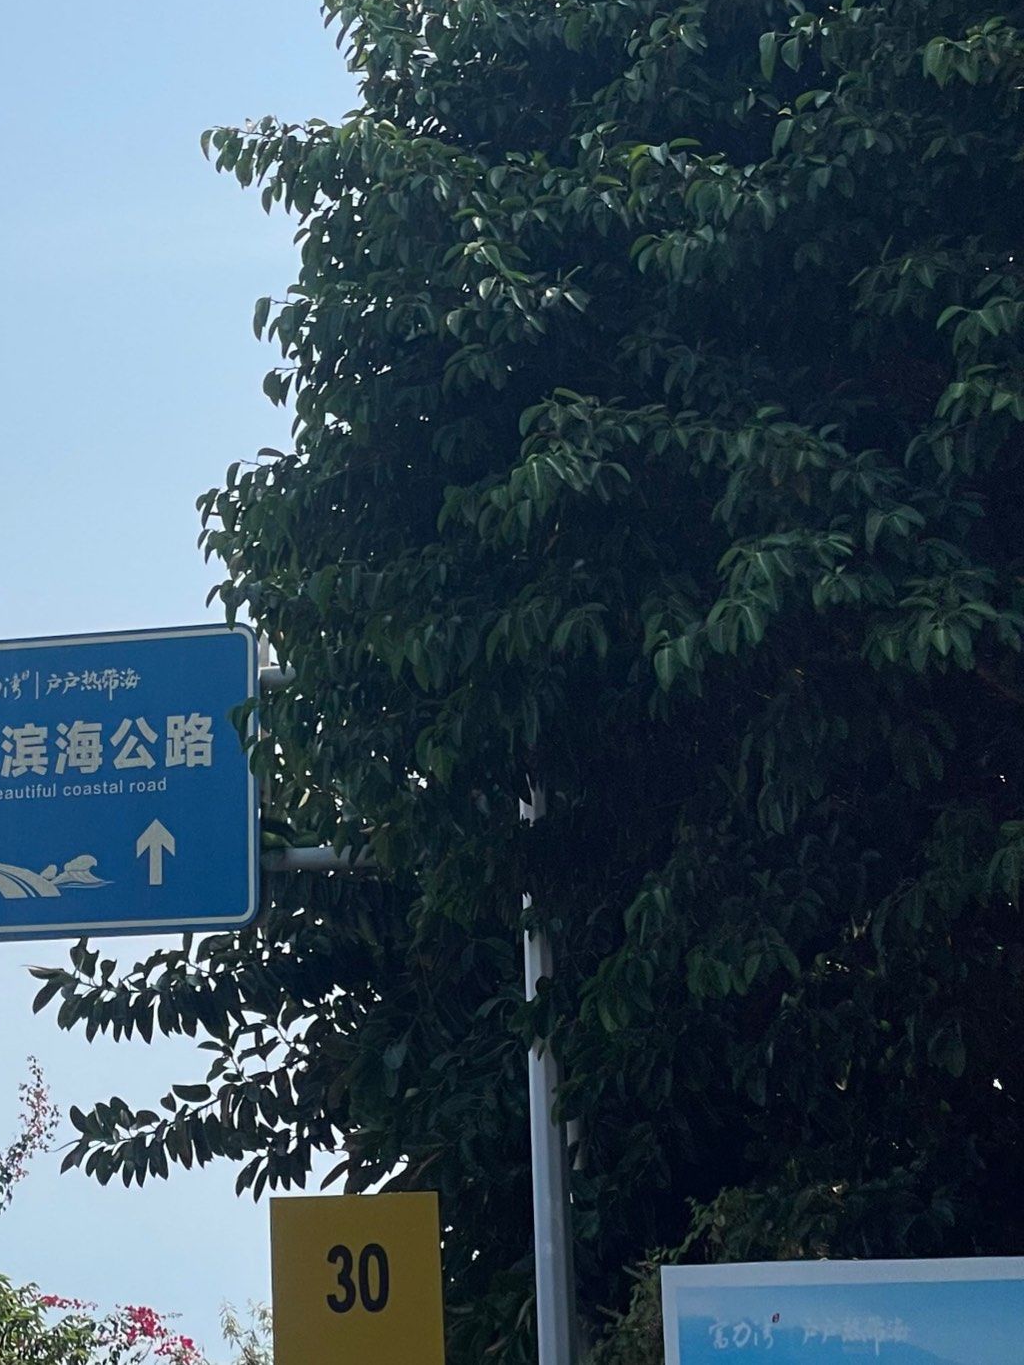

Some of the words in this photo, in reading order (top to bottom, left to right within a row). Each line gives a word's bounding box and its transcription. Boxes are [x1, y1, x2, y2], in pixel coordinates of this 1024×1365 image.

[63, 779, 123, 797] coastal
[129, 777, 167, 793] road
[326, 1242, 390, 1314] 30
